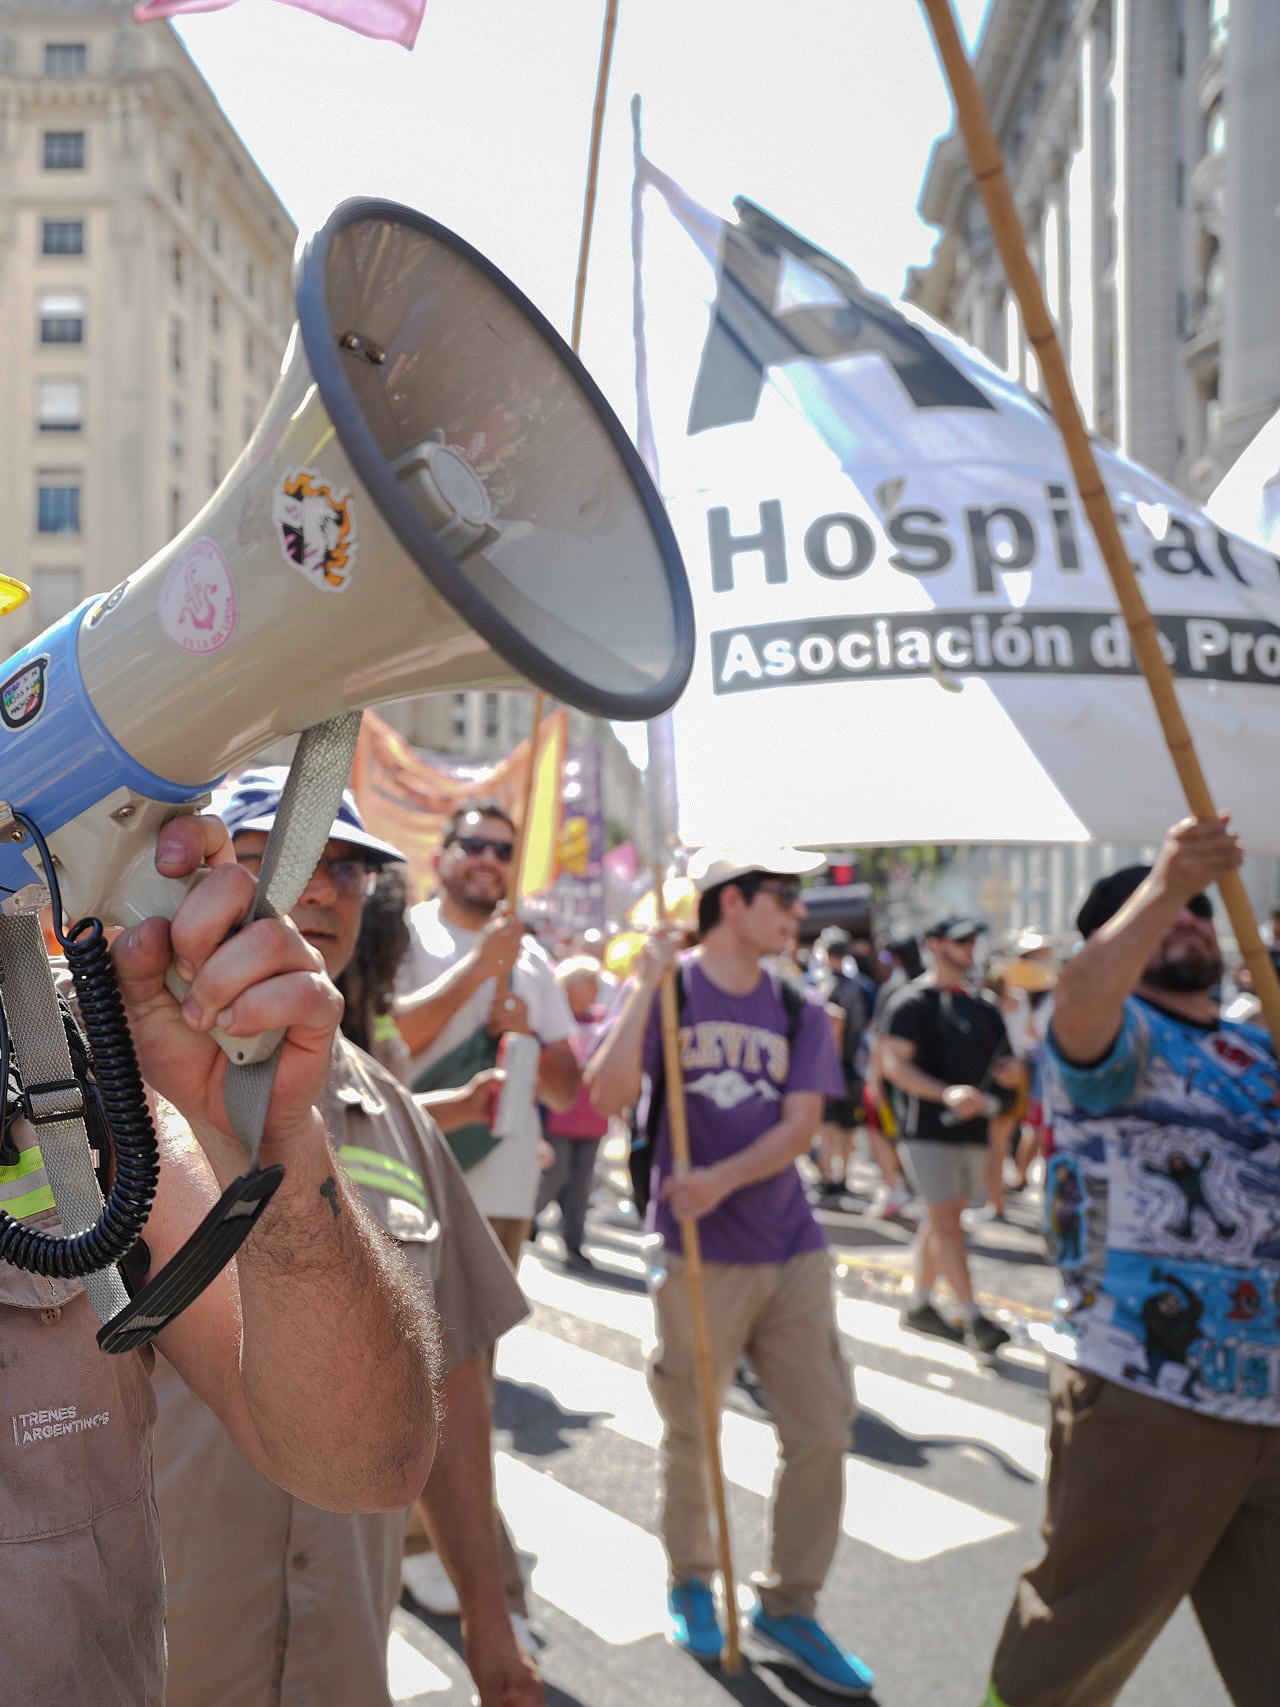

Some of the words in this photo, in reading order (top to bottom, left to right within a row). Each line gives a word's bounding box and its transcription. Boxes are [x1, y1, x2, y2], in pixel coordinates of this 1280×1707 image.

[707, 484, 1249, 594] Hospial
[722, 613, 1074, 682] Asociación
[1091, 615, 1176, 669] d
[19, 1405, 77, 1428] TRENES
[22, 1411, 110, 1445] ARGENTINOS
